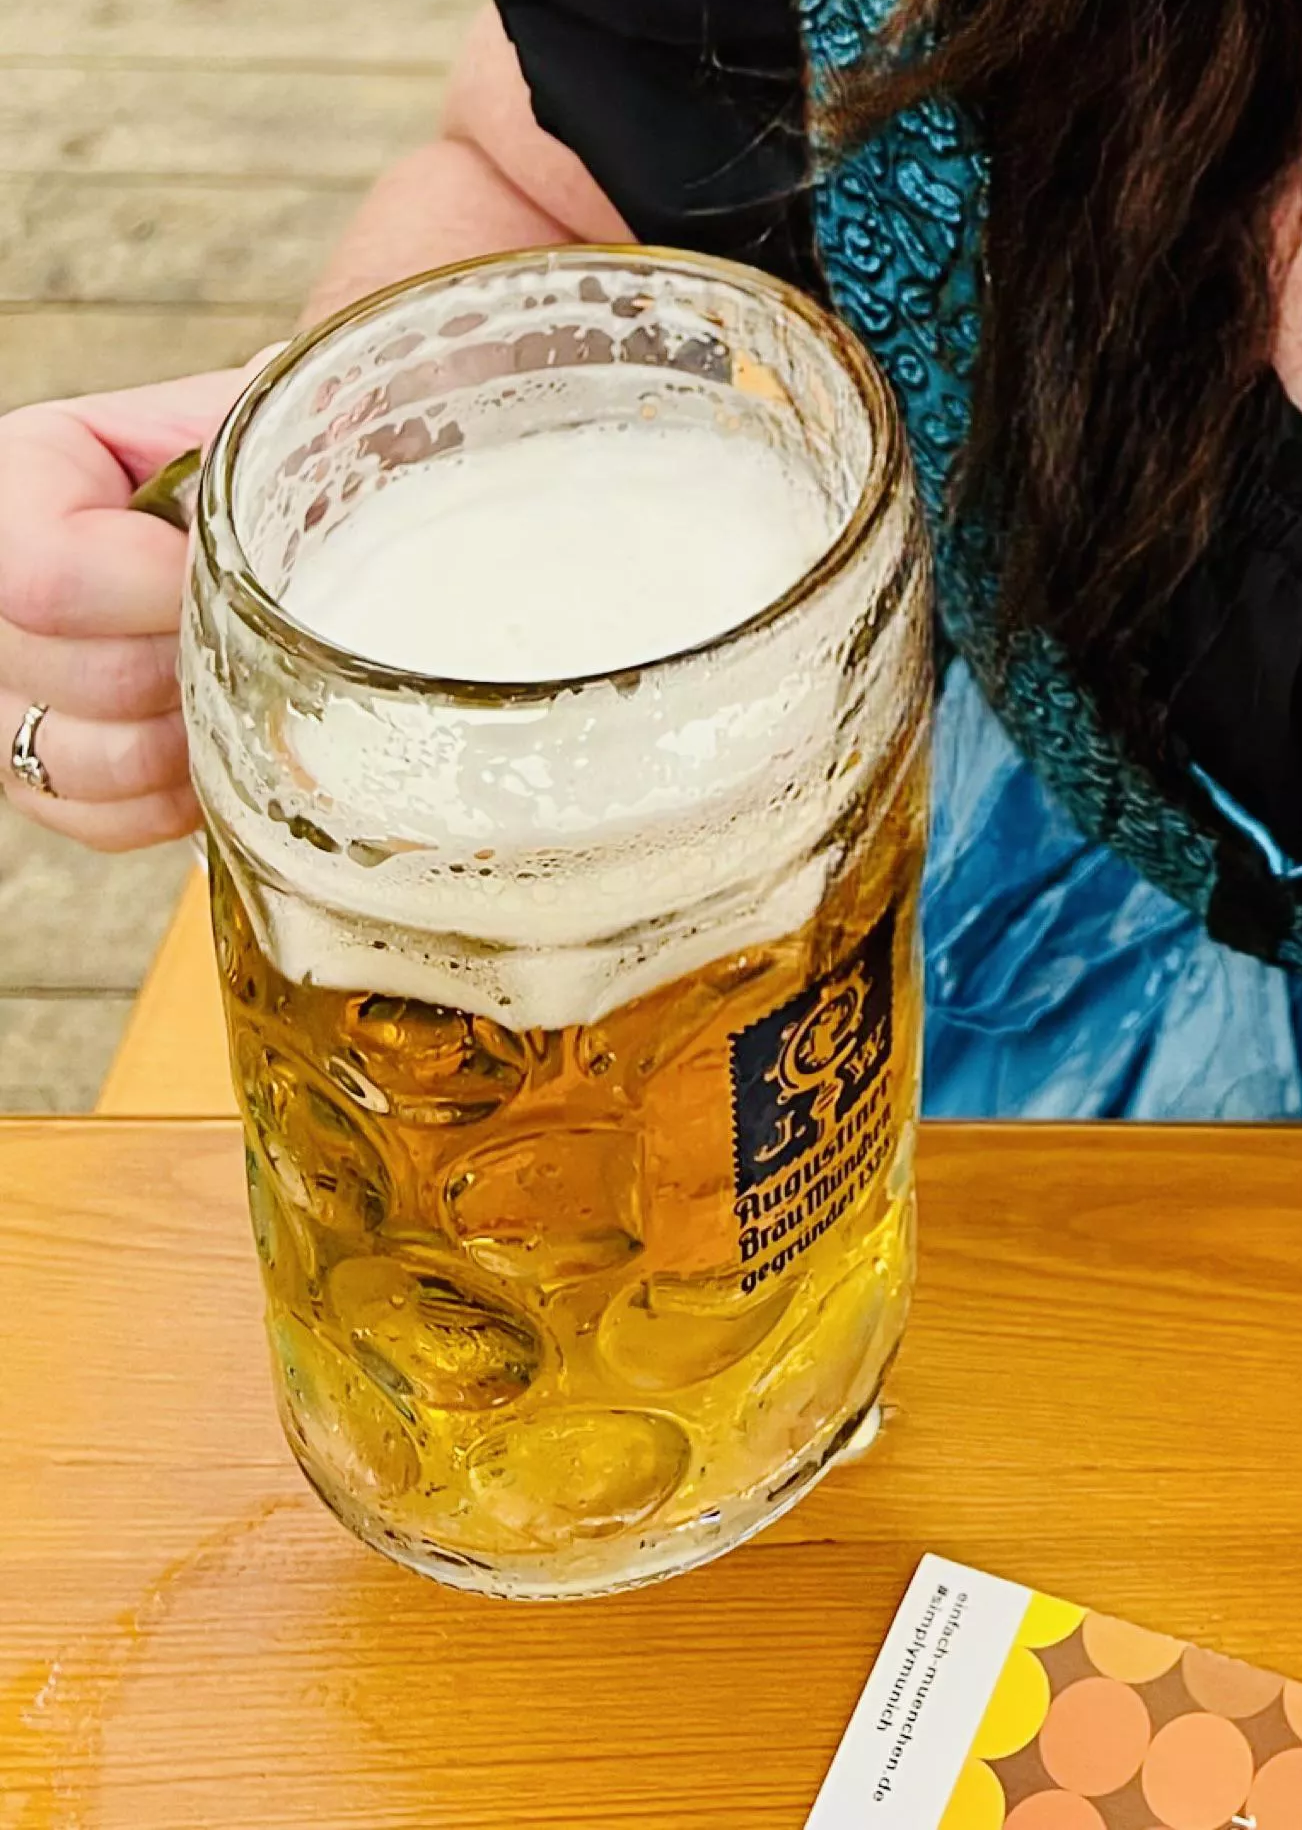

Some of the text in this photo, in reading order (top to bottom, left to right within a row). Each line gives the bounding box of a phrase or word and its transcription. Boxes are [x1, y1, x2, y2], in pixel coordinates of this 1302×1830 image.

[733, 1069, 892, 1228] Augustiner
[739, 1102, 892, 1263] Bräu München
[740, 1183, 856, 1295] gegründet
[872, 1592, 969, 1803] einfach-muenchen.de
[876, 1583, 949, 1733] #simplymunich
